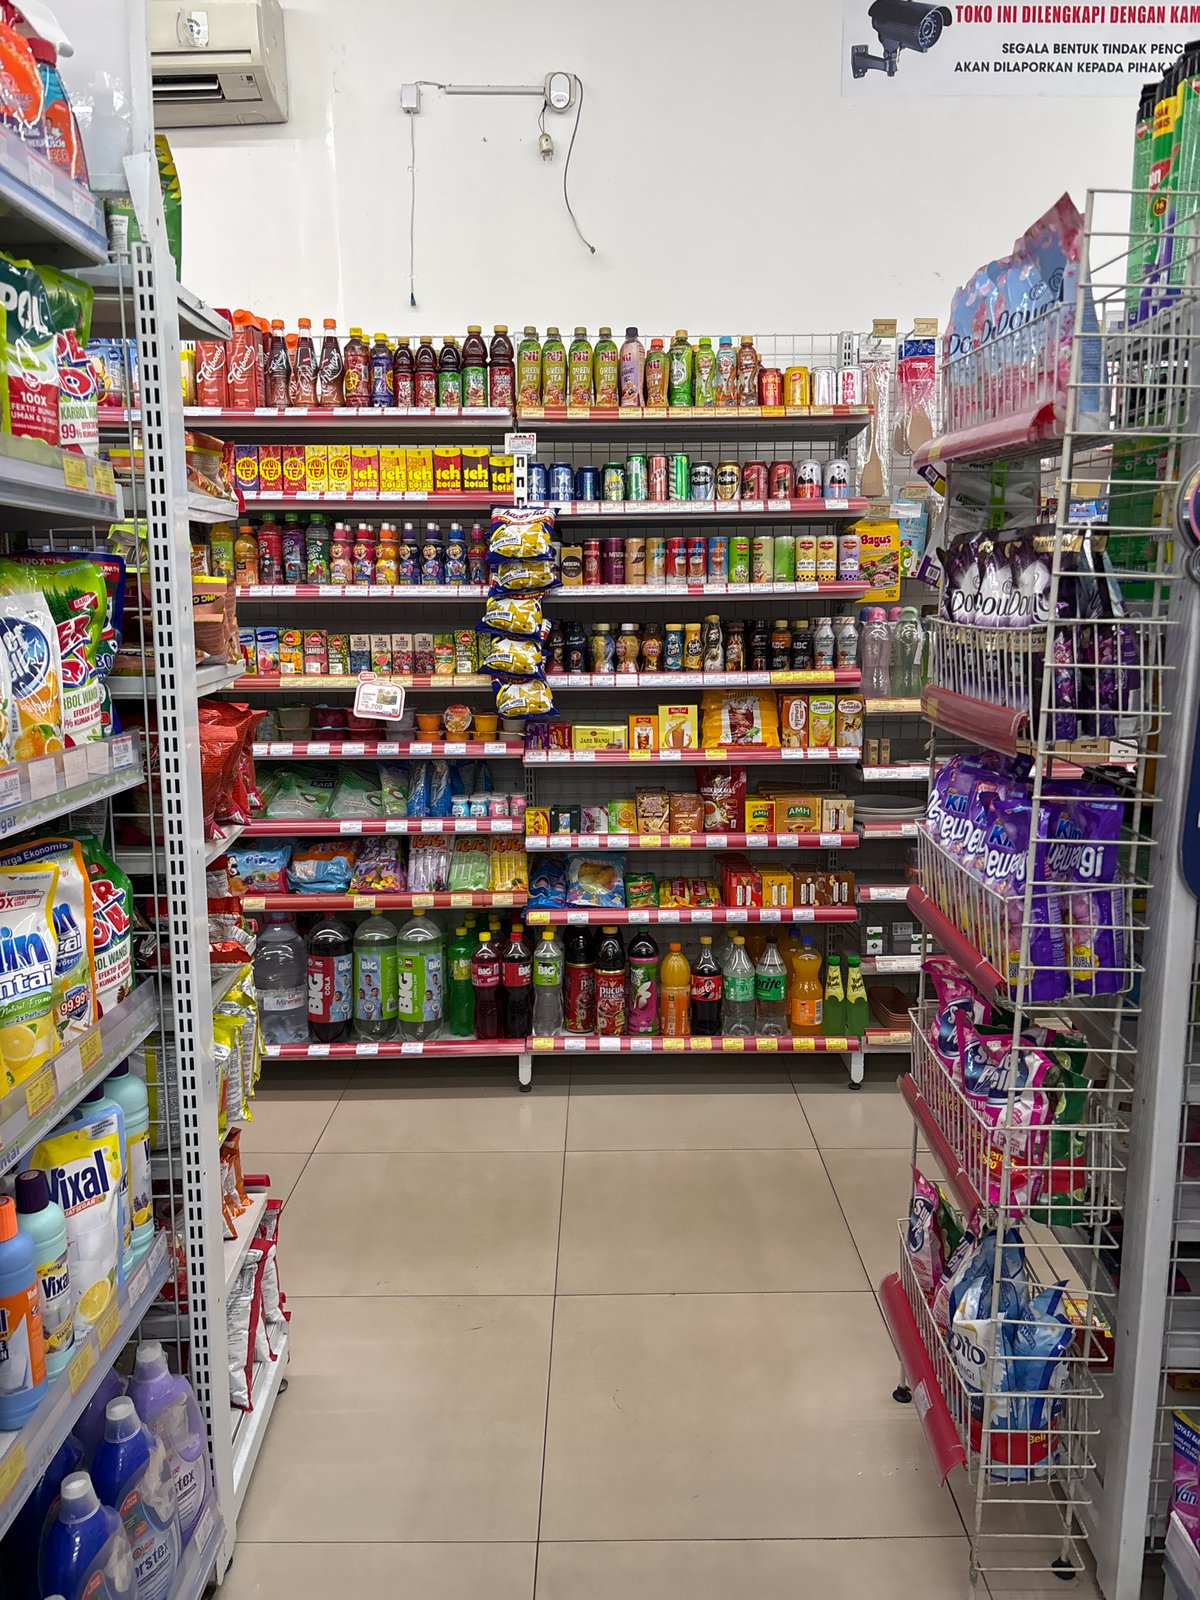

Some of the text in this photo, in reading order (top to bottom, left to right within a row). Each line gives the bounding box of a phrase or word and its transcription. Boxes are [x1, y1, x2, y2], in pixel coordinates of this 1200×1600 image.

[955, 6, 993, 23] TOKO
[999, 6, 1017, 23] INI
[1022, 6, 1106, 24] DILENGKAPI
[1110, 6, 1166, 24] DENGAN
[1002, 43, 1049, 55] SEGALA
[1053, 43, 1099, 55] BENTUK
[1102, 43, 1147, 55] TINDAK
[954, 62, 990, 73] AKAN
[993, 62, 1073, 73] DILAPORKAN
[1076, 62, 1124, 73] KEPADA
[1127, 62, 1165, 73] PIHAK
[20, 391, 48, 407] 100X
[11, 403, 37, 413] FEKTIF
[60, 406, 86, 420] KARBOL
[11, 411, 35, 421] UMAN
[238, 460, 256, 469] FRUIT
[261, 460, 279, 469] FRUIT
[285, 460, 303, 469] FRUIT
[307, 460, 324, 469] FRUIT
[331, 460, 348, 469] FRUIT
[238, 468, 255, 478] TEA
[262, 468, 279, 478] TEA
[286, 468, 303, 478] TEA
[308, 468, 325, 478] TEA
[331, 468, 348, 478] TEA
[353, 465, 377, 480] teh
[381, 465, 405, 480] teh
[408, 465, 432, 480] teh
[436, 464, 460, 480] teh
[464, 464, 488, 480] teh
[691, 475, 711, 483] Polaris
[718, 474, 738, 483] Polaris
[353, 480, 378, 488] kotak
[382, 481, 406, 489] kotak
[409, 481, 433, 489] kotak
[436, 480, 461, 488] kotak
[464, 480, 488, 488] kotak
[492, 483, 514, 491] kota
[860, 534, 892, 546] Bagus
[256, 633, 278, 641] Buavita
[306, 647, 325, 655] JAMBU
[788, 806, 810, 815] AMH
[23, 842, 68, 859] Ekonomis
[108, 946, 128, 966] WANGI
[361, 961, 378, 970] BIG
[98, 966, 117, 980] EFEKTIF
[538, 966, 555, 976] BIG
[307, 972, 324, 1016] BIG
[398, 972, 413, 1015] BIG
[60, 988, 91, 1016] 99.99%
[50, 1149, 110, 1211] Vixal
[1030, 1434, 1046, 1444] Beli
